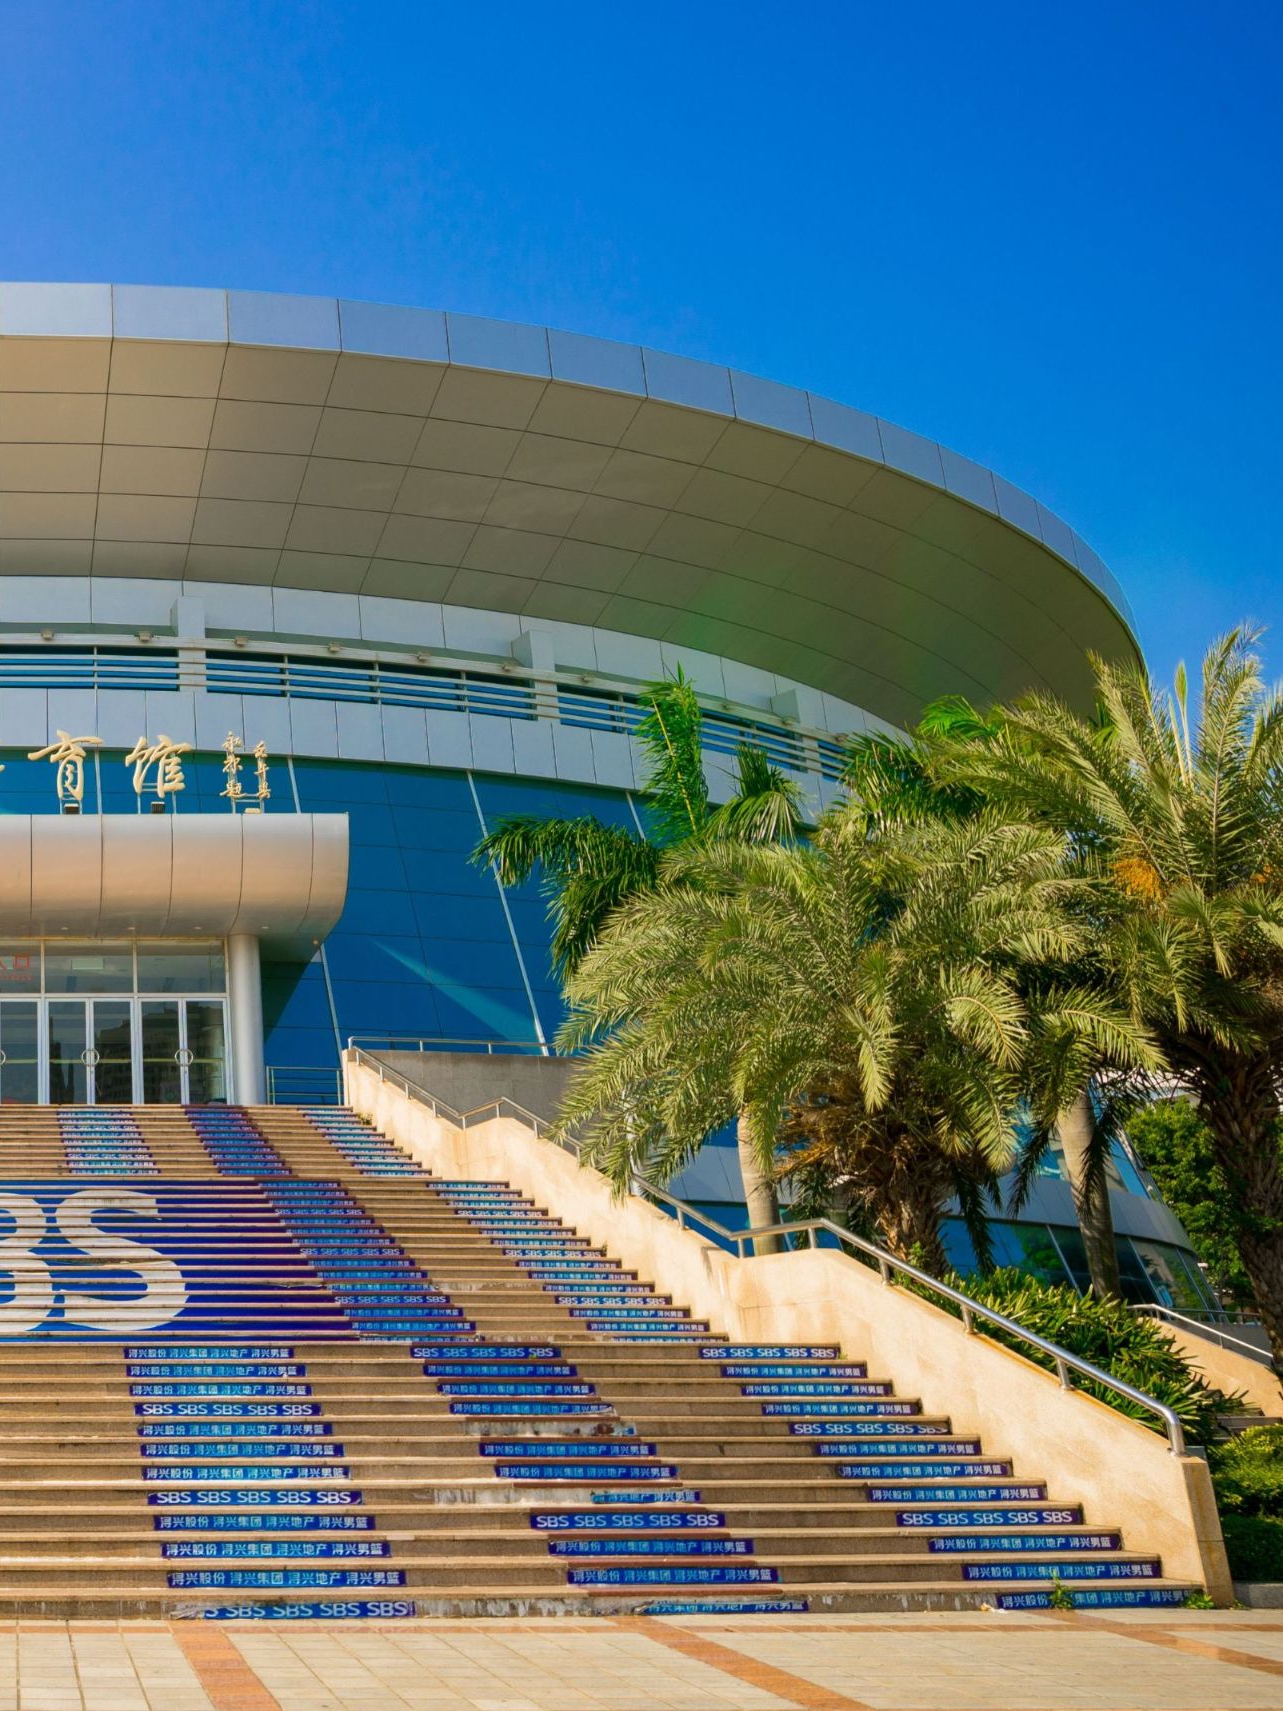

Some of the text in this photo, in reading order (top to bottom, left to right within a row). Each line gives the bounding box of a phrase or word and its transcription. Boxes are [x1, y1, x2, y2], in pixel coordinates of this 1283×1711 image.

[414, 1347, 553, 1358] SBS SBS SBS SBS SBS
[703, 1348, 835, 1359] SBS SBS SBS SBS SBS
[132, 1385, 307, 1395] 浔兴股份 浔兴集团 浔兴地产 浔兴男篮
[142, 1404, 312, 1415] SBS SBS SBS SBS SBS
[794, 1423, 821, 1434] SBS
[825, 1423, 853, 1434] SBS
[857, 1423, 884, 1434] SBS
[889, 1423, 916, 1434] SBS
[157, 1491, 351, 1504] SBS SBS SBS SBS SBS
[872, 1487, 1041, 1500] 浔兴股份 浔兴集团 浔兴地产 浔兴男篮
[160, 1516, 368, 1529] 浔兴股份 浔兴集团 浔兴地产 浔兴男篮
[536, 1515, 719, 1527] SBS SBS SBS SBS SBS
[903, 1510, 1072, 1525] SBS SBS SBS SBS SBS
[166, 1543, 382, 1556] 浔兴股份 浔兴集团 浔兴地产 浔兴男篮
[573, 1568, 772, 1582] 浔兴股份 浔兴集团 浔兴地产 浔兴男篮
[968, 1564, 1153, 1579] 浔兴股份 浔兴集团 浔兴地产 浔兴男篮
[172, 1572, 400, 1586] 浔兴股份 浔兴集团 浔兴地产 浔兴男篮
[226, 1602, 266, 1616] SBS
[273, 1602, 313, 1616] SBS
[320, 1602, 361, 1616] SBS
[368, 1602, 408, 1616] SBS
